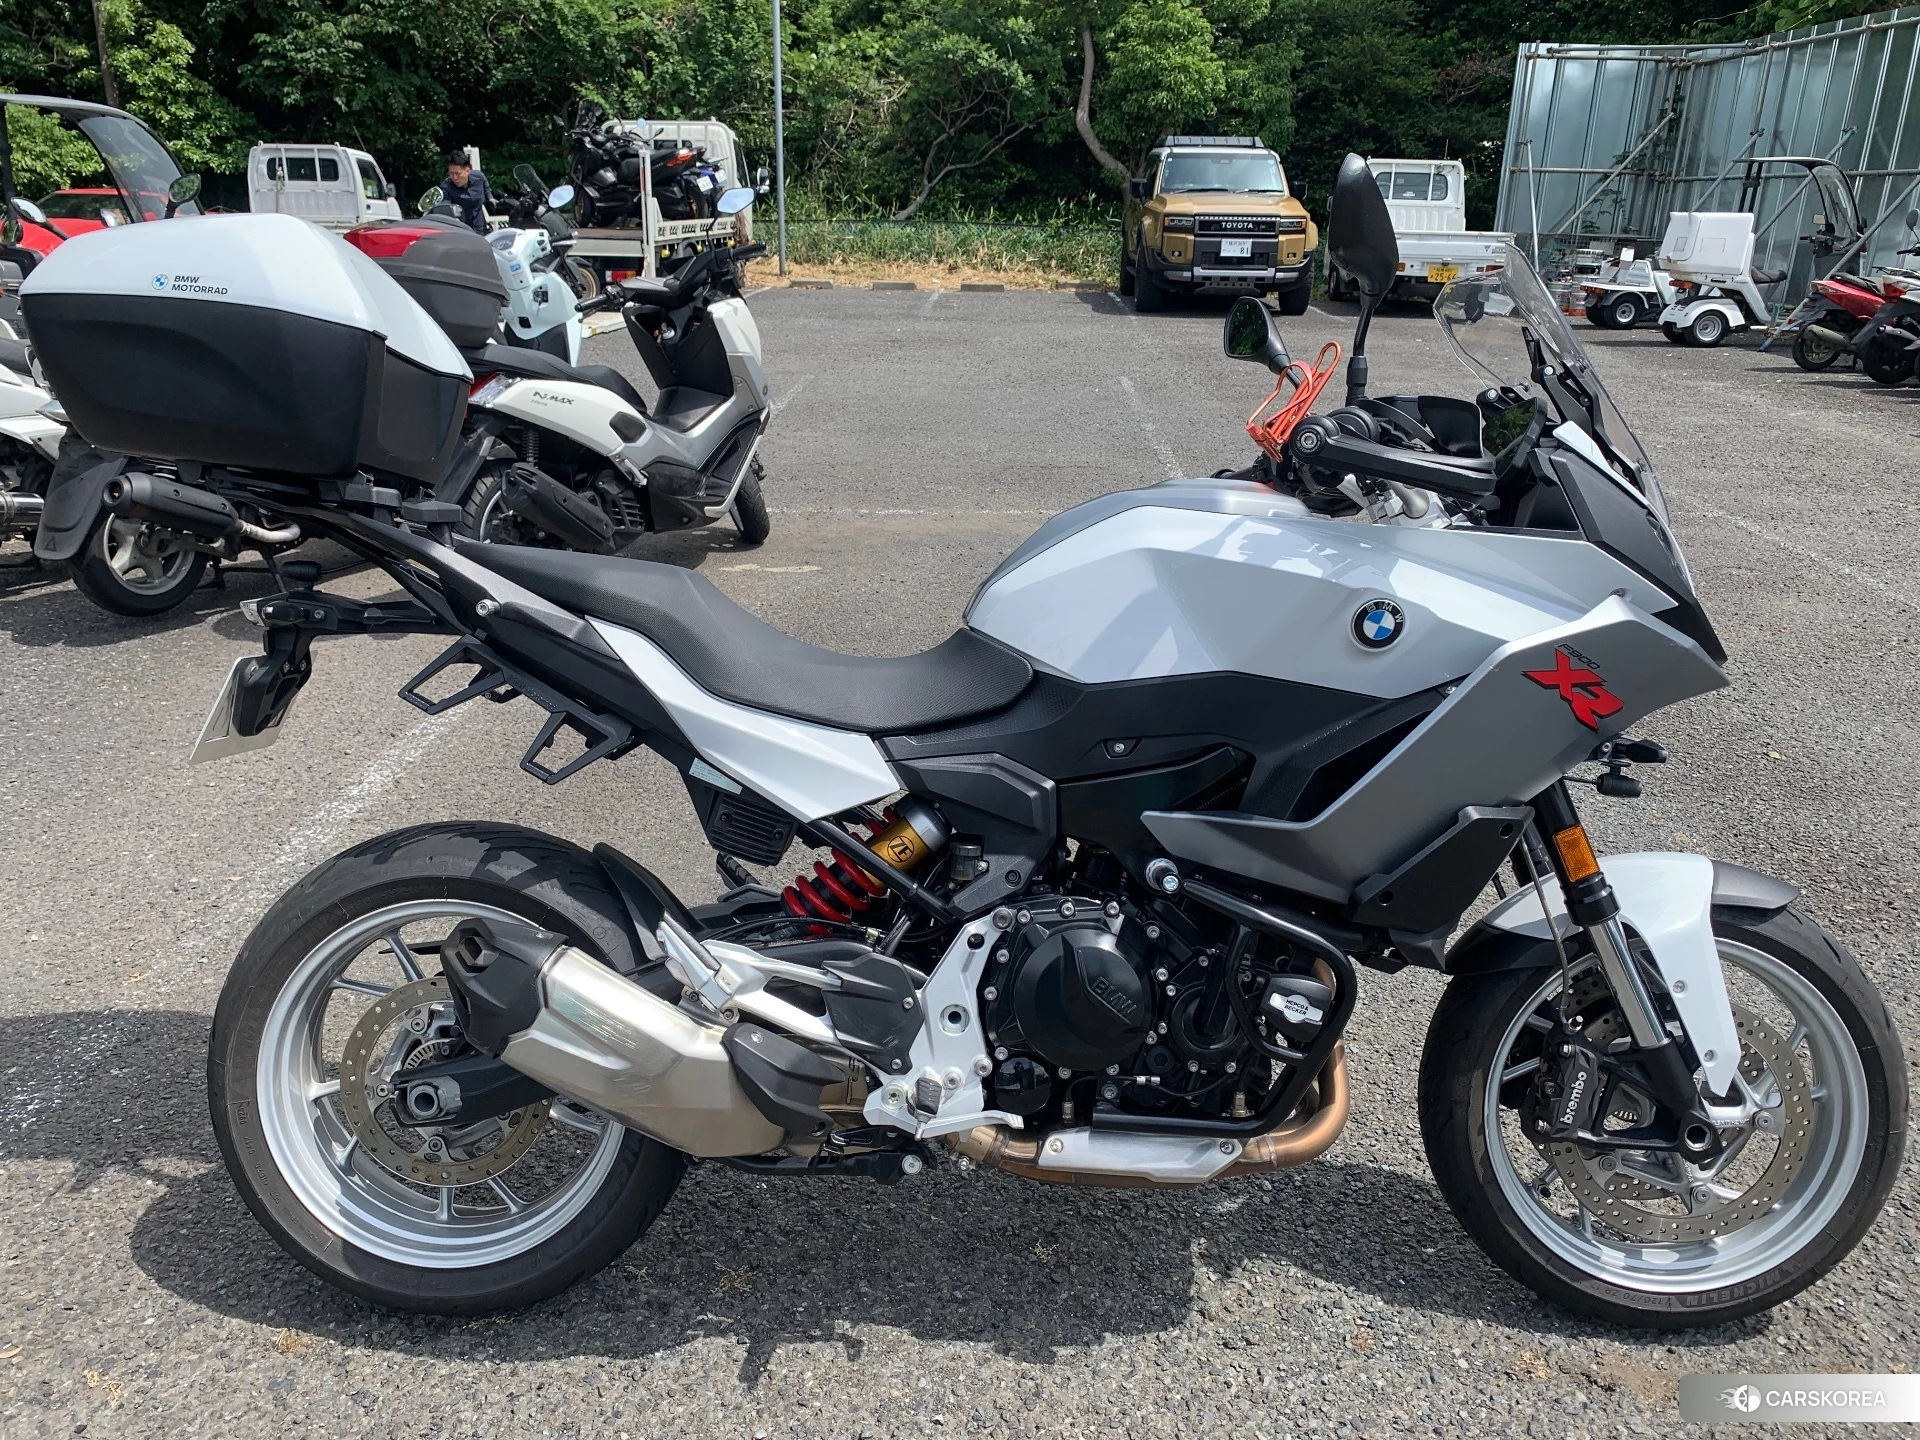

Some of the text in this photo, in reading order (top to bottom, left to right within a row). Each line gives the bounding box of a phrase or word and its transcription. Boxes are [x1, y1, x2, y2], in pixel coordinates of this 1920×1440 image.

[1221, 221, 1254, 229] TOYOTA
[1239, 246, 1250, 255] 81
[171, 283, 228, 295] MOTORRAD
[174, 275, 200, 284] BMW
[1365, 601, 1403, 623] BMW
[1555, 643, 1601, 670] F900
[1520, 648, 1625, 735] XR
[888, 836, 915, 862] ZF
[1091, 976, 1138, 1016] BMW
[1284, 1004, 1308, 1016] BECKER
[1560, 1071, 1587, 1125] brembo
[1623, 1292, 1662, 1305] 120/70
[1685, 1269, 1781, 1306] MICHELIN
